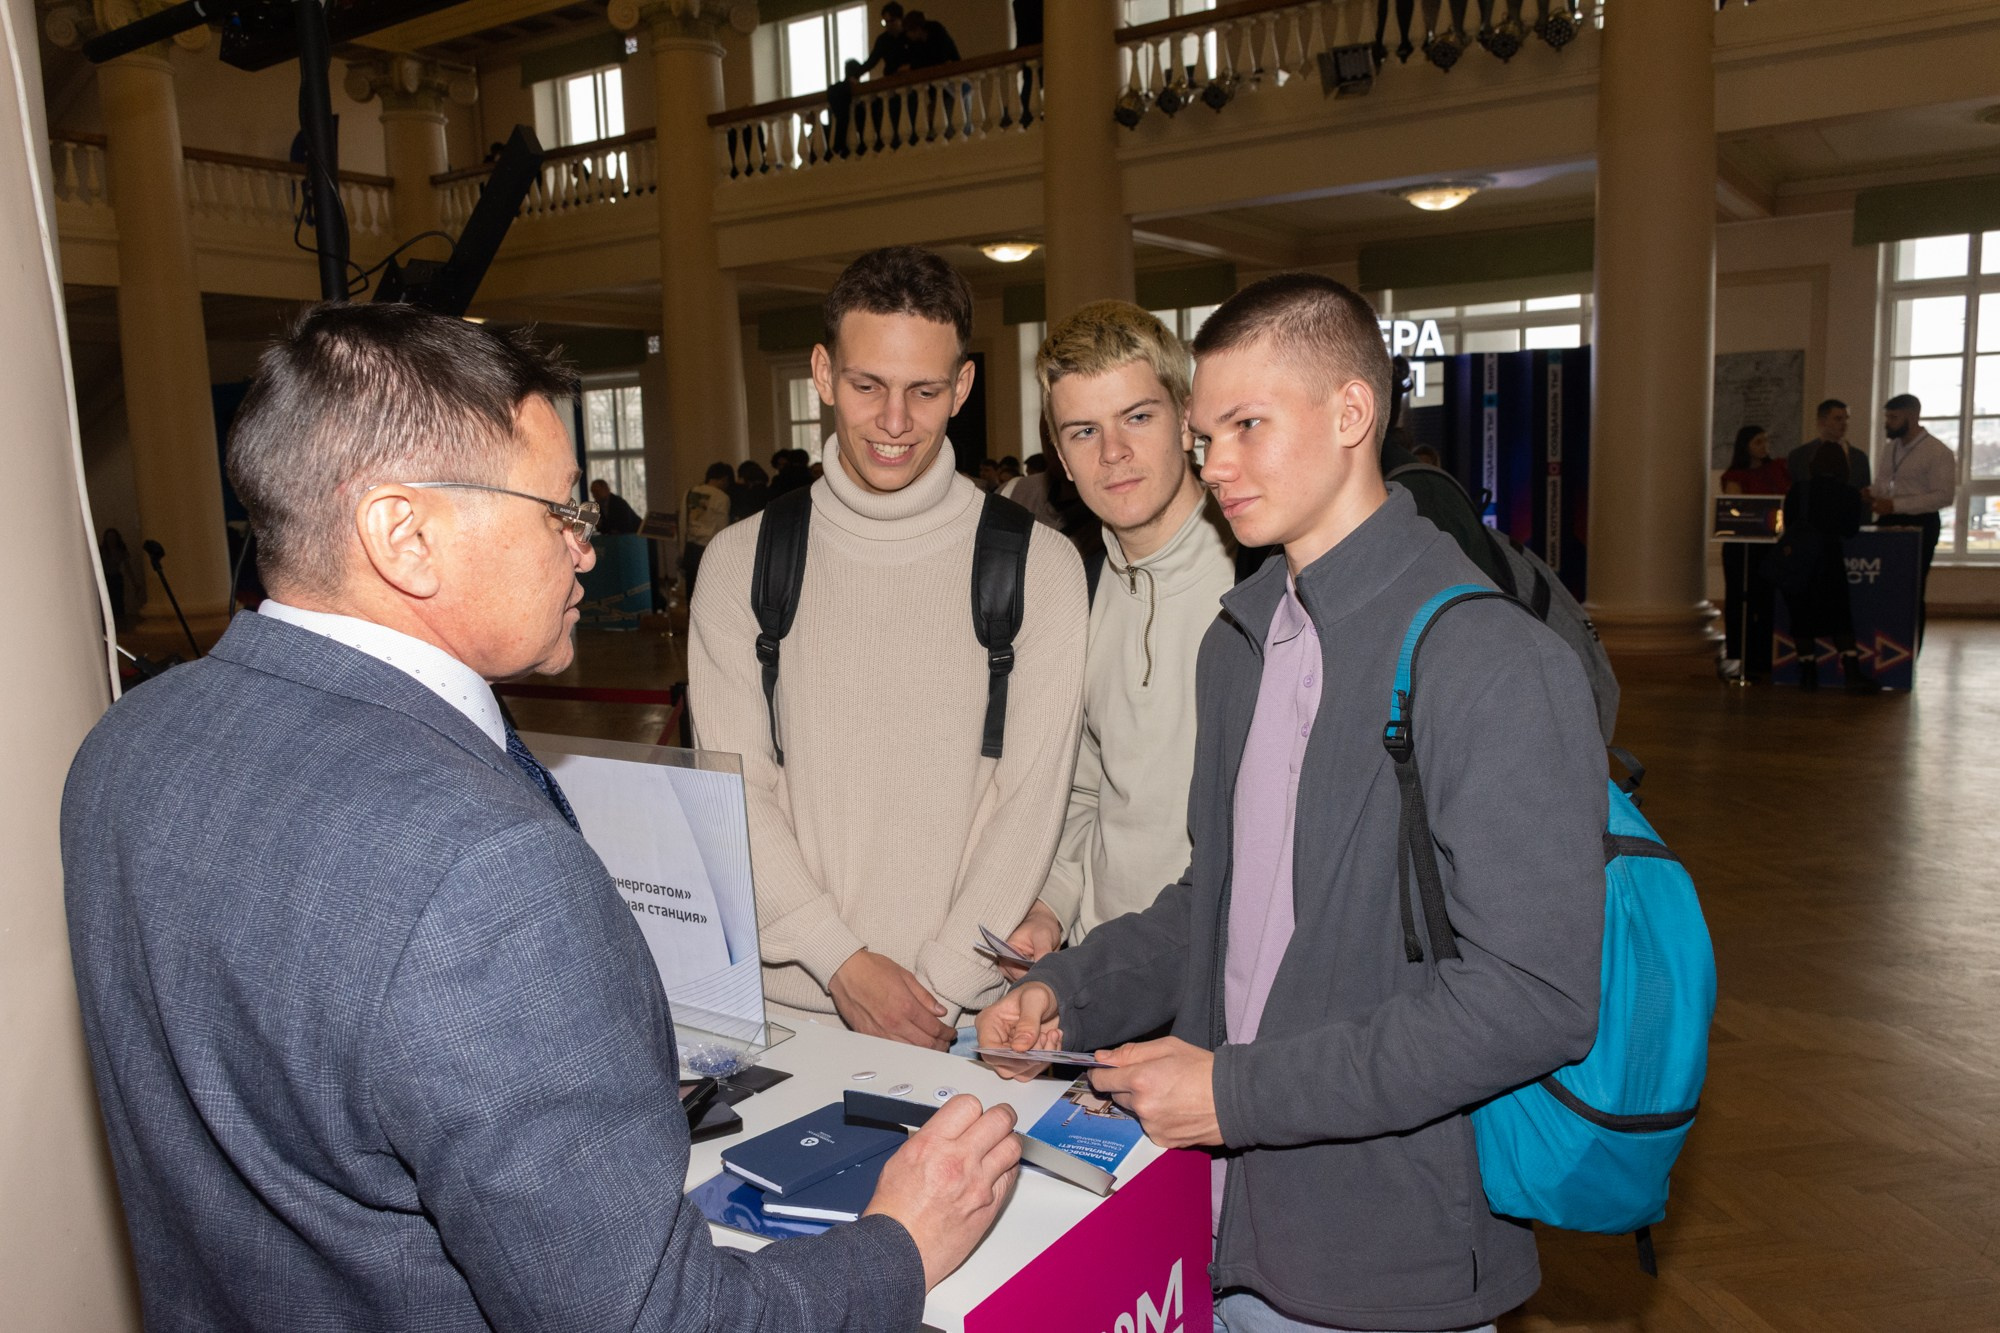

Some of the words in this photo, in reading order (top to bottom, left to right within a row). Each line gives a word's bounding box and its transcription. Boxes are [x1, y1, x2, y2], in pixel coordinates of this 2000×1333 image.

[647, 904, 707, 924] станция»
[1058, 1143, 1118, 1158] ПРИГЛАШАЕТ!
[1060, 1148, 1114, 1162] БАЛАКОВСК
